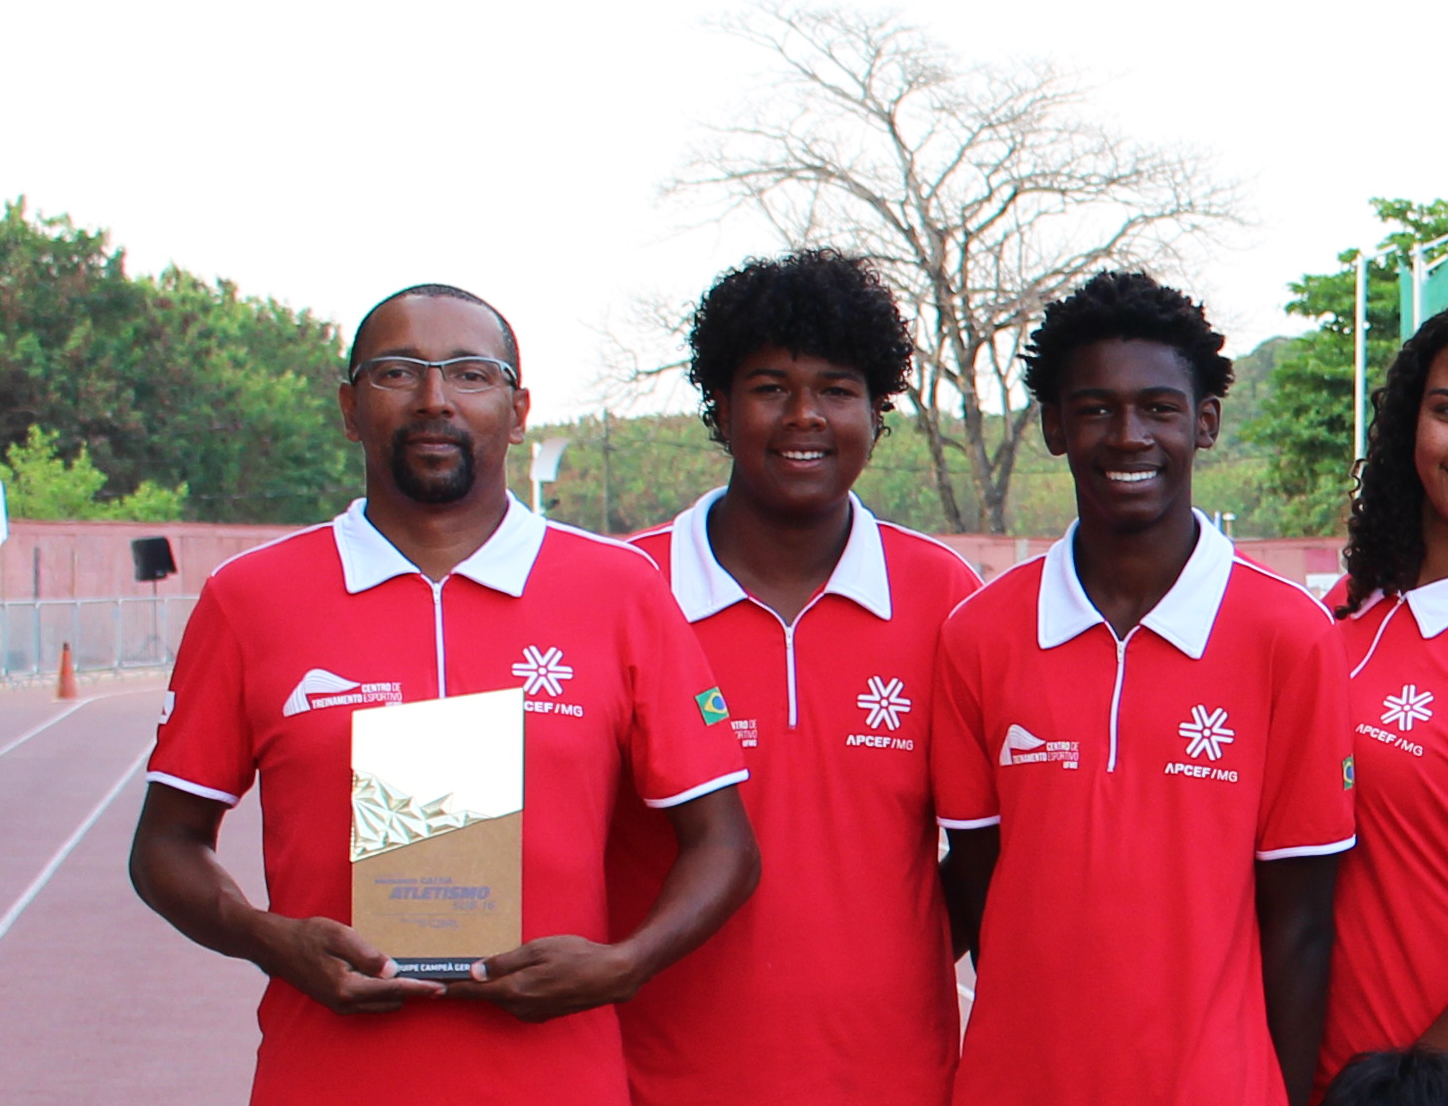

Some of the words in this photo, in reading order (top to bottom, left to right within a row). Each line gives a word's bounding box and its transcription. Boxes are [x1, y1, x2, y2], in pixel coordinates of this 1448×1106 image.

[846, 734, 914, 751] APCEF/MG
[1356, 723, 1423, 757] APCEF/MG
[1164, 763, 1238, 782] APCEF/MG
[389, 886, 491, 899] ATLETISMO
